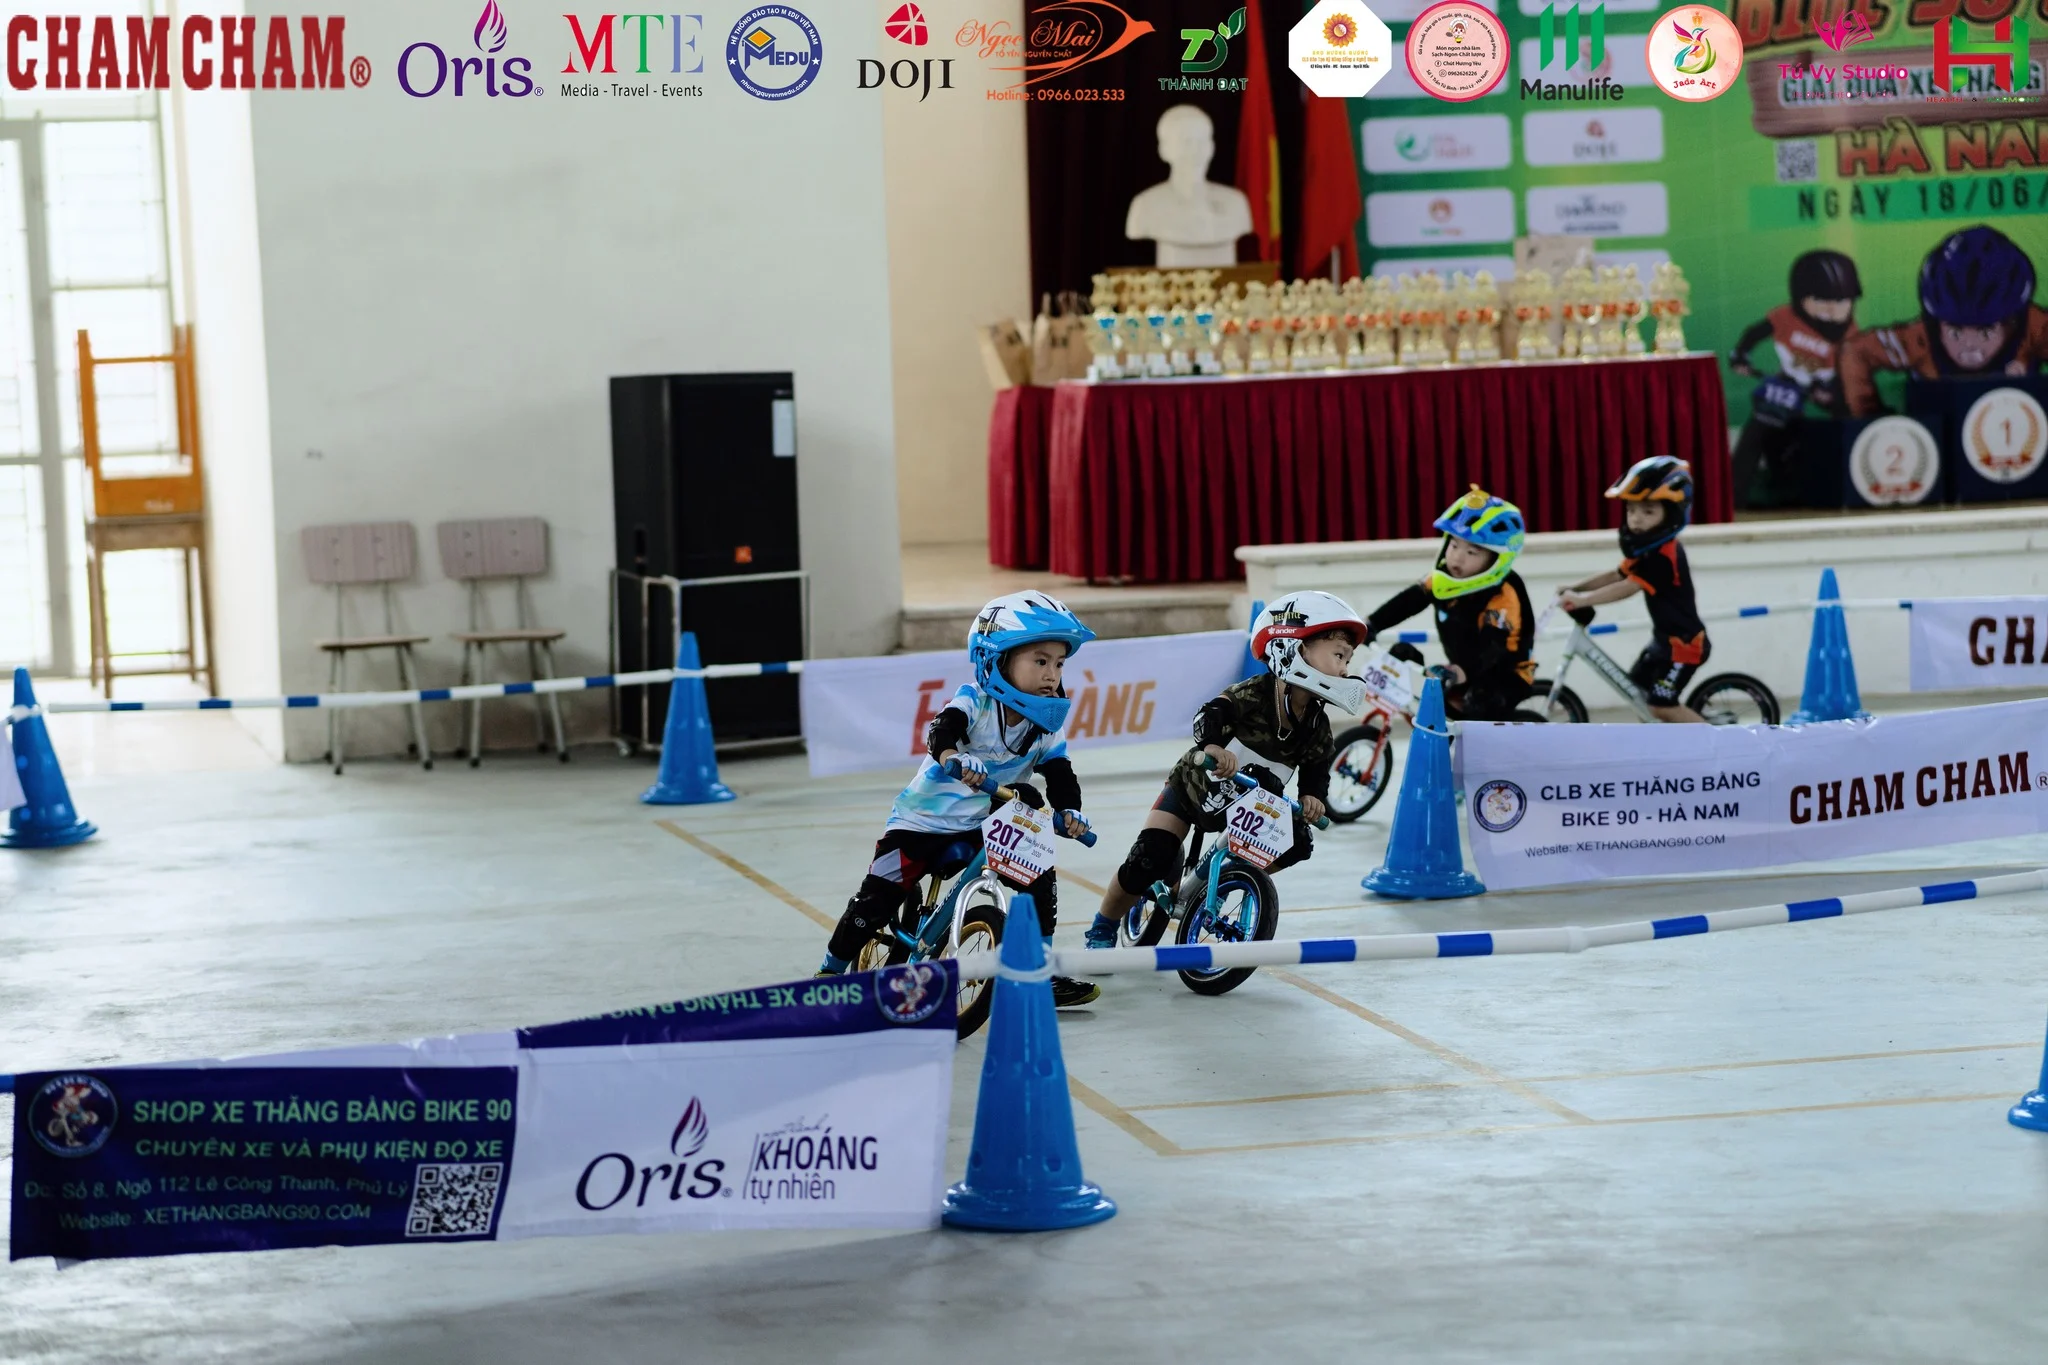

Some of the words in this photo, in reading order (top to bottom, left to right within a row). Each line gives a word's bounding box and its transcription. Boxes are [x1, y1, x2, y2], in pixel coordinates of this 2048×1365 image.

[1884, 444, 1905, 477] 2
[1969, 613, 2048, 666] CH
[1365, 666, 1388, 690] 206
[1540, 785, 1582, 801] CLB
[1588, 782, 1616, 799] XE
[1622, 775, 1695, 797] THĂNG
[1701, 770, 1761, 792] BẰNG
[1789, 770, 1905, 825] CHAM
[1231, 806, 1265, 838] 202
[1561, 811, 1610, 827] BIKE
[1616, 809, 1639, 825] 90
[1658, 802, 1688, 823] HÀ
[1694, 802, 1740, 821] NAM
[986, 818, 1025, 852] 207
[1525, 844, 1573, 859] Website:
[1576, 834, 1726, 852] XETHANGBANG90.COM
[767, 986, 796, 1008] XE
[802, 983, 863, 1006] SHOP
[133, 1101, 206, 1124] SHOP
[211, 1101, 245, 1123] XE
[252, 1095, 339, 1123] THĂNG
[424, 1099, 479, 1122] BIKE
[485, 1099, 512, 1121] 90
[135, 1137, 236, 1158] CHUYÊN
[242, 1140, 274, 1158] XE
[281, 1137, 312, 1158] VÀ
[320, 1141, 365, 1163] PHỤ
[373, 1139, 428, 1162] KIỆN
[474, 1140, 504, 1158] XE
[754, 1127, 878, 1171] KHOÁNG
[61, 1180, 88, 1199] Số
[158, 1176, 190, 1193] 112
[194, 1176, 218, 1192] Lê
[223, 1175, 272, 1194] Công
[386, 1180, 408, 1198] Lý
[750, 1175, 773, 1205] tự
[777, 1172, 835, 1200] nhiên
[143, 1203, 372, 1226] XETHANGBANG90.COM
